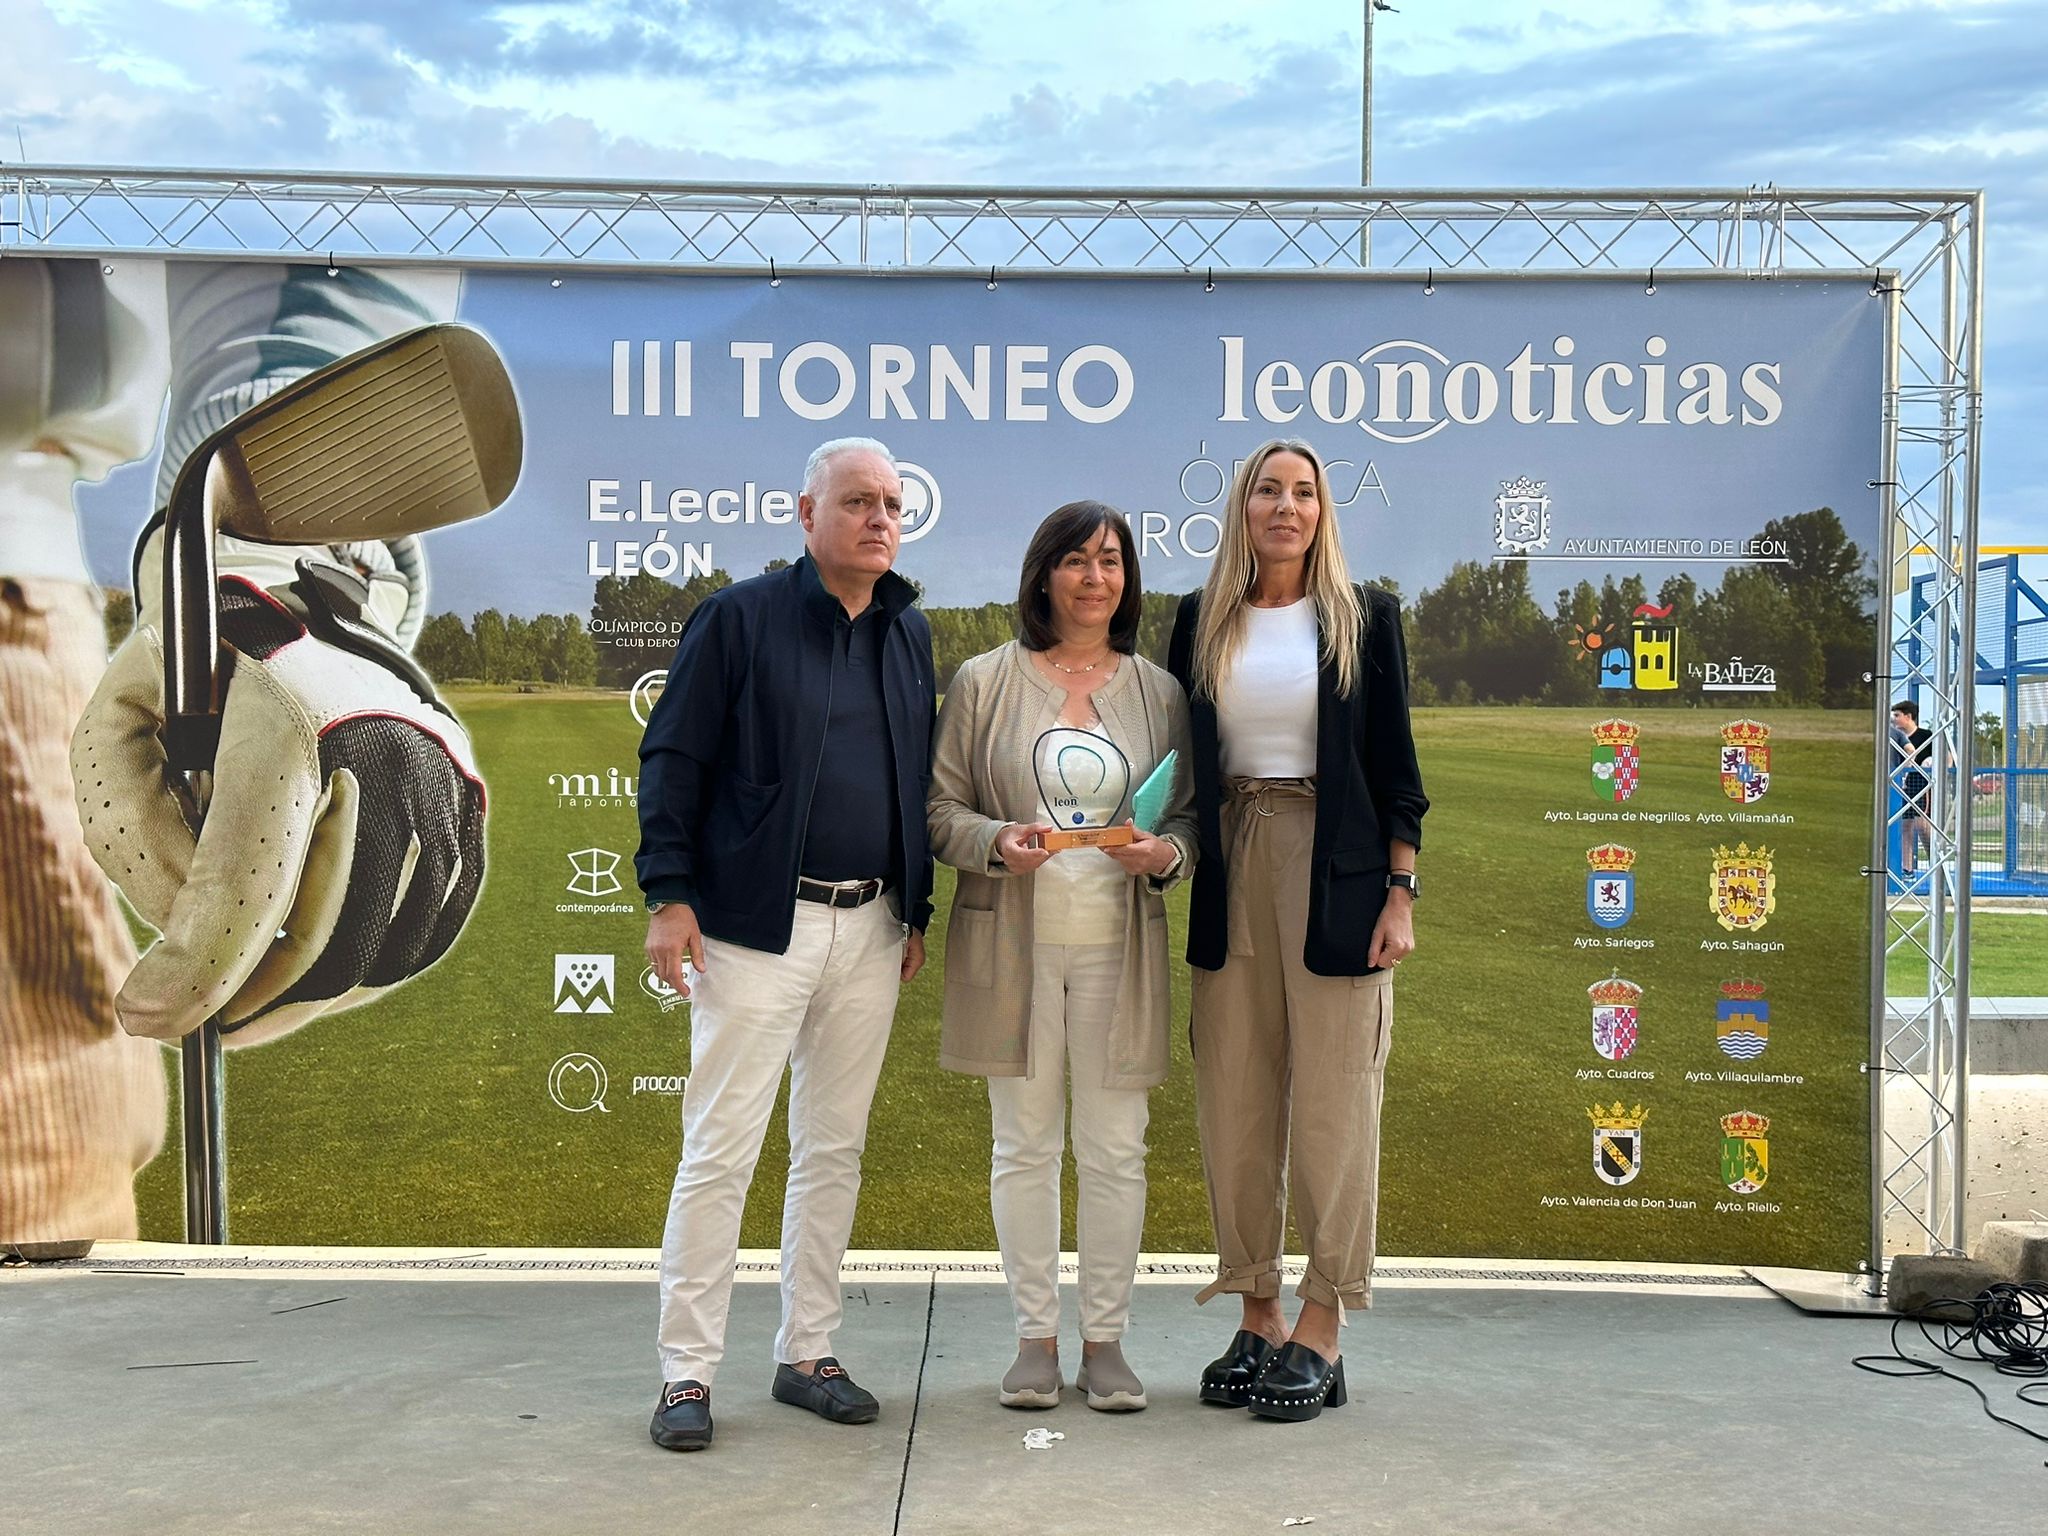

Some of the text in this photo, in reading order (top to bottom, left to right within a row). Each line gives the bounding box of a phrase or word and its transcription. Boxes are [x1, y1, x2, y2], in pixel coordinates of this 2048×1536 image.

[613, 340, 1135, 423] III TORNEO
[1218, 335, 1783, 443] leonoticias
[588, 479, 802, 525] E.Lecle
[1564, 536, 1787, 556] AYUNTAMIENTO DE LEÓN
[588, 529, 712, 578] LEÓN
[615, 638, 645, 647] CLUB
[1544, 811, 1691, 825] Ayto. Laguna de Negrillos
[1696, 812, 1794, 825] Ayto. Villamañán
[556, 903, 634, 913] contemporánea
[1574, 937, 1655, 950] Ayto. Sariegos
[1700, 940, 1785, 953] Ayto. Sahagún
[1575, 1068, 1654, 1080] Ayto. Cuadros
[1685, 1070, 1804, 1085] Ayto. Villaquilambre
[1541, 1195, 1697, 1210] Ayto. Valencia de Don Juan
[1714, 1201, 1781, 1213] Ayto. Riello
